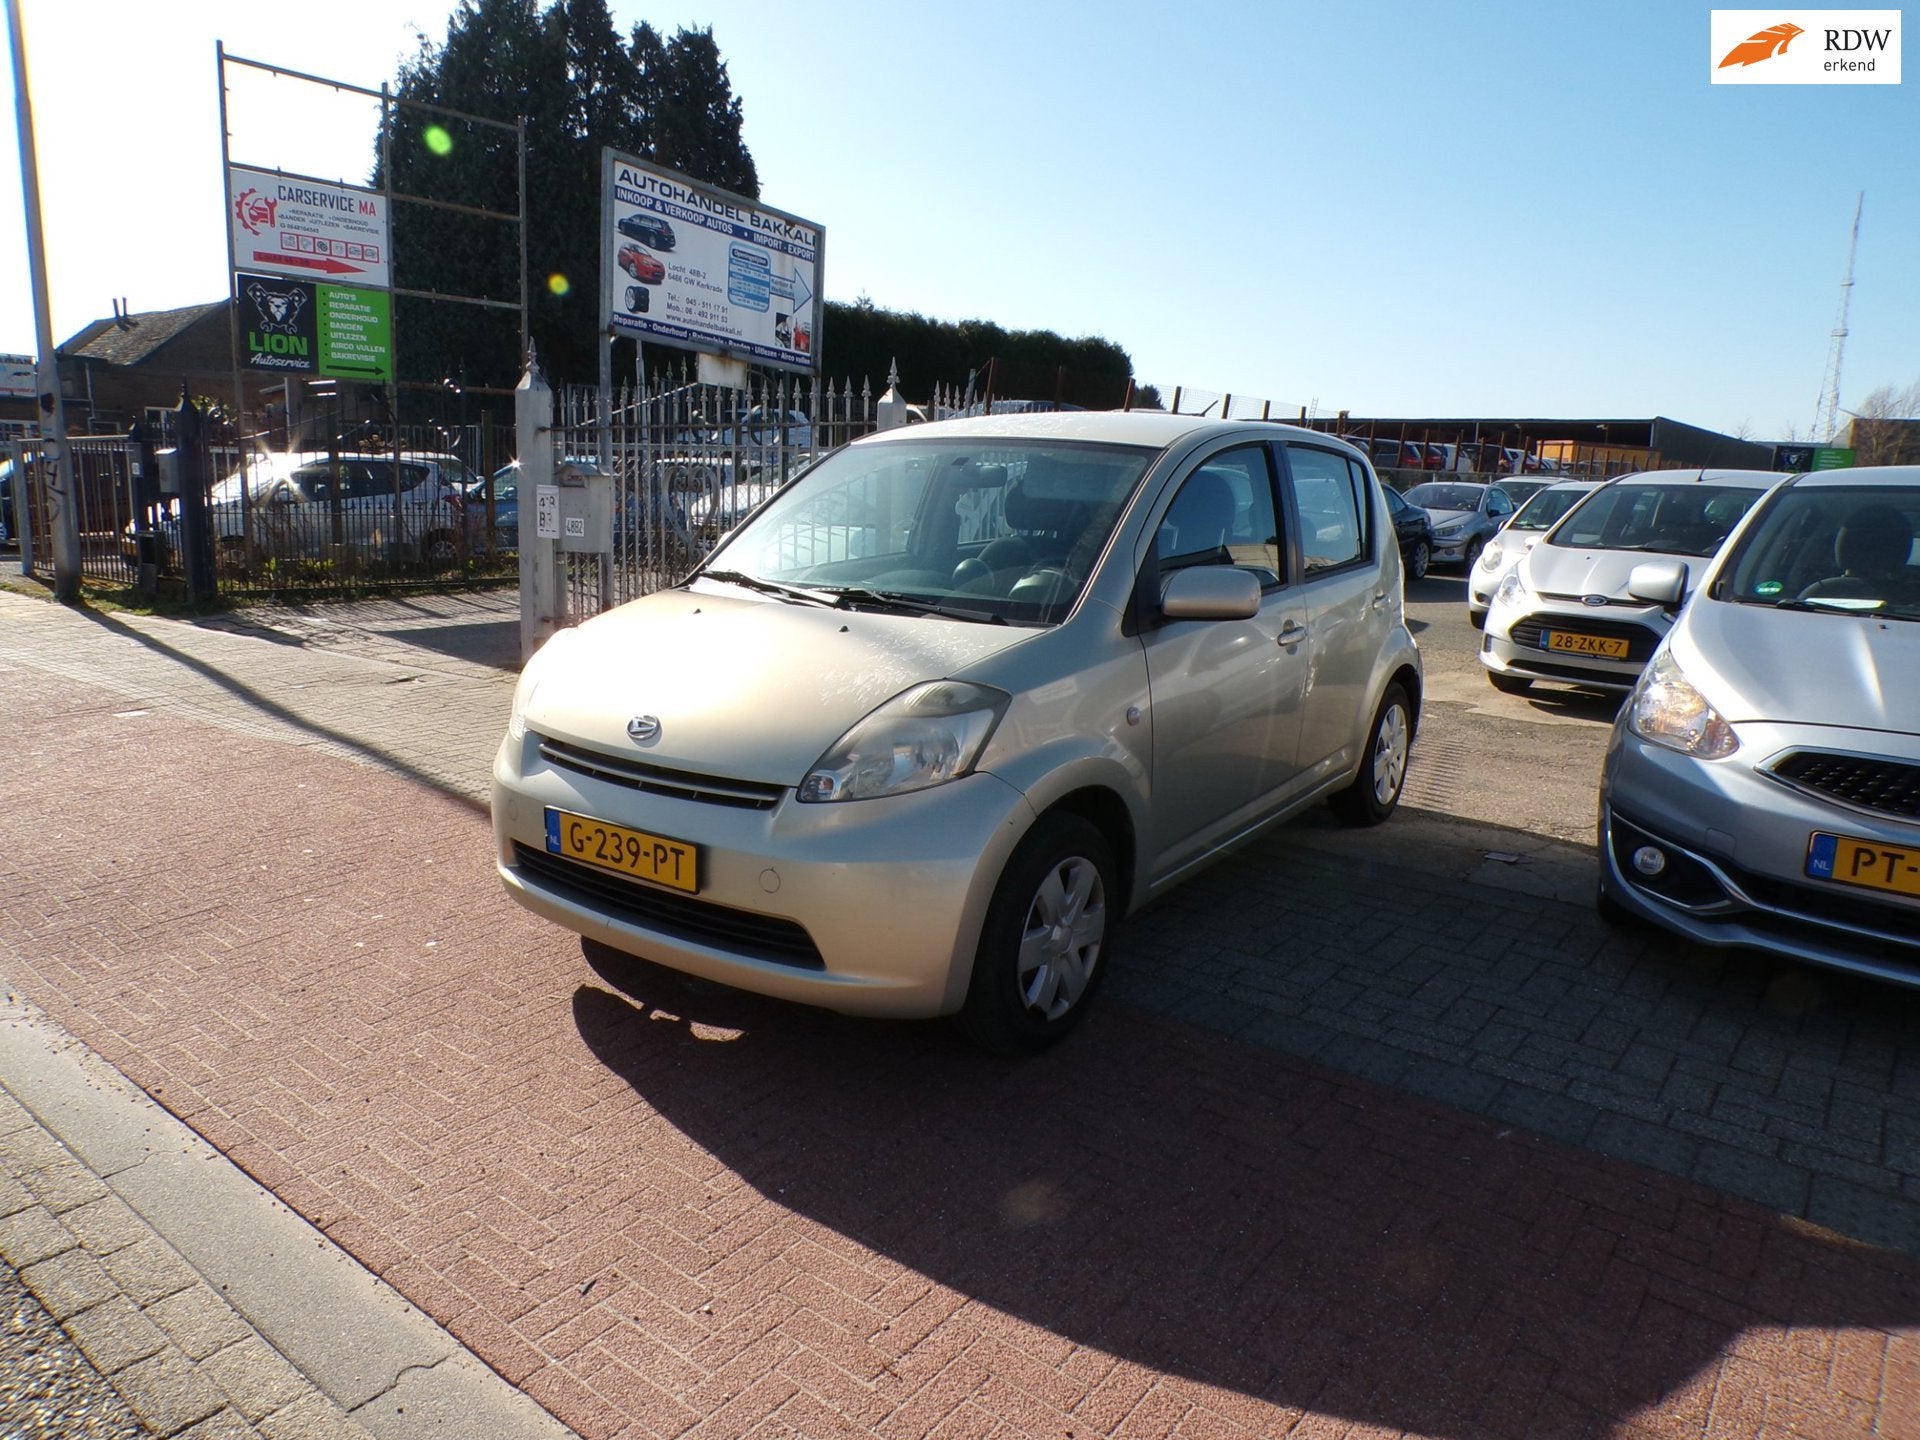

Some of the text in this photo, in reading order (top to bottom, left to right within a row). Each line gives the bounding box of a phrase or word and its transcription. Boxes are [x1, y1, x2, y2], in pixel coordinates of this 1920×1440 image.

[278, 185, 377, 217] CARSERVICE MA
[618, 169, 816, 247] AUTOHANDEL BAKKALI
[616, 187, 653, 208] INKOOP
[654, 202, 663, 211] &
[664, 202, 705, 225] VERKOOP
[706, 219, 733, 234] AUTOS
[753, 232, 783, 250] IMPORT
[787, 243, 815, 260] EXPORT
[668, 262, 686, 273] Locht
[684, 277, 695, 286] GW
[696, 281, 723, 293] Kerkrade
[329, 301, 371, 312] REPARATIE
[329, 311, 379, 323] ONDERHOUD
[330, 321, 363, 331] BANDEN
[613, 314, 648, 329] Reparatie
[652, 323, 688, 338] Onderhoud
[249, 331, 308, 356] LION
[330, 331, 367, 341] UITLEZEN
[331, 341, 386, 353] AIRCO VULLEN
[250, 352, 310, 369] Autoservice
[1555, 634, 1623, 654] 28-ZKK-7
[549, 835, 560, 846] NL
[570, 822, 685, 880] G-239-PT
[1813, 858, 1830, 871] NL
